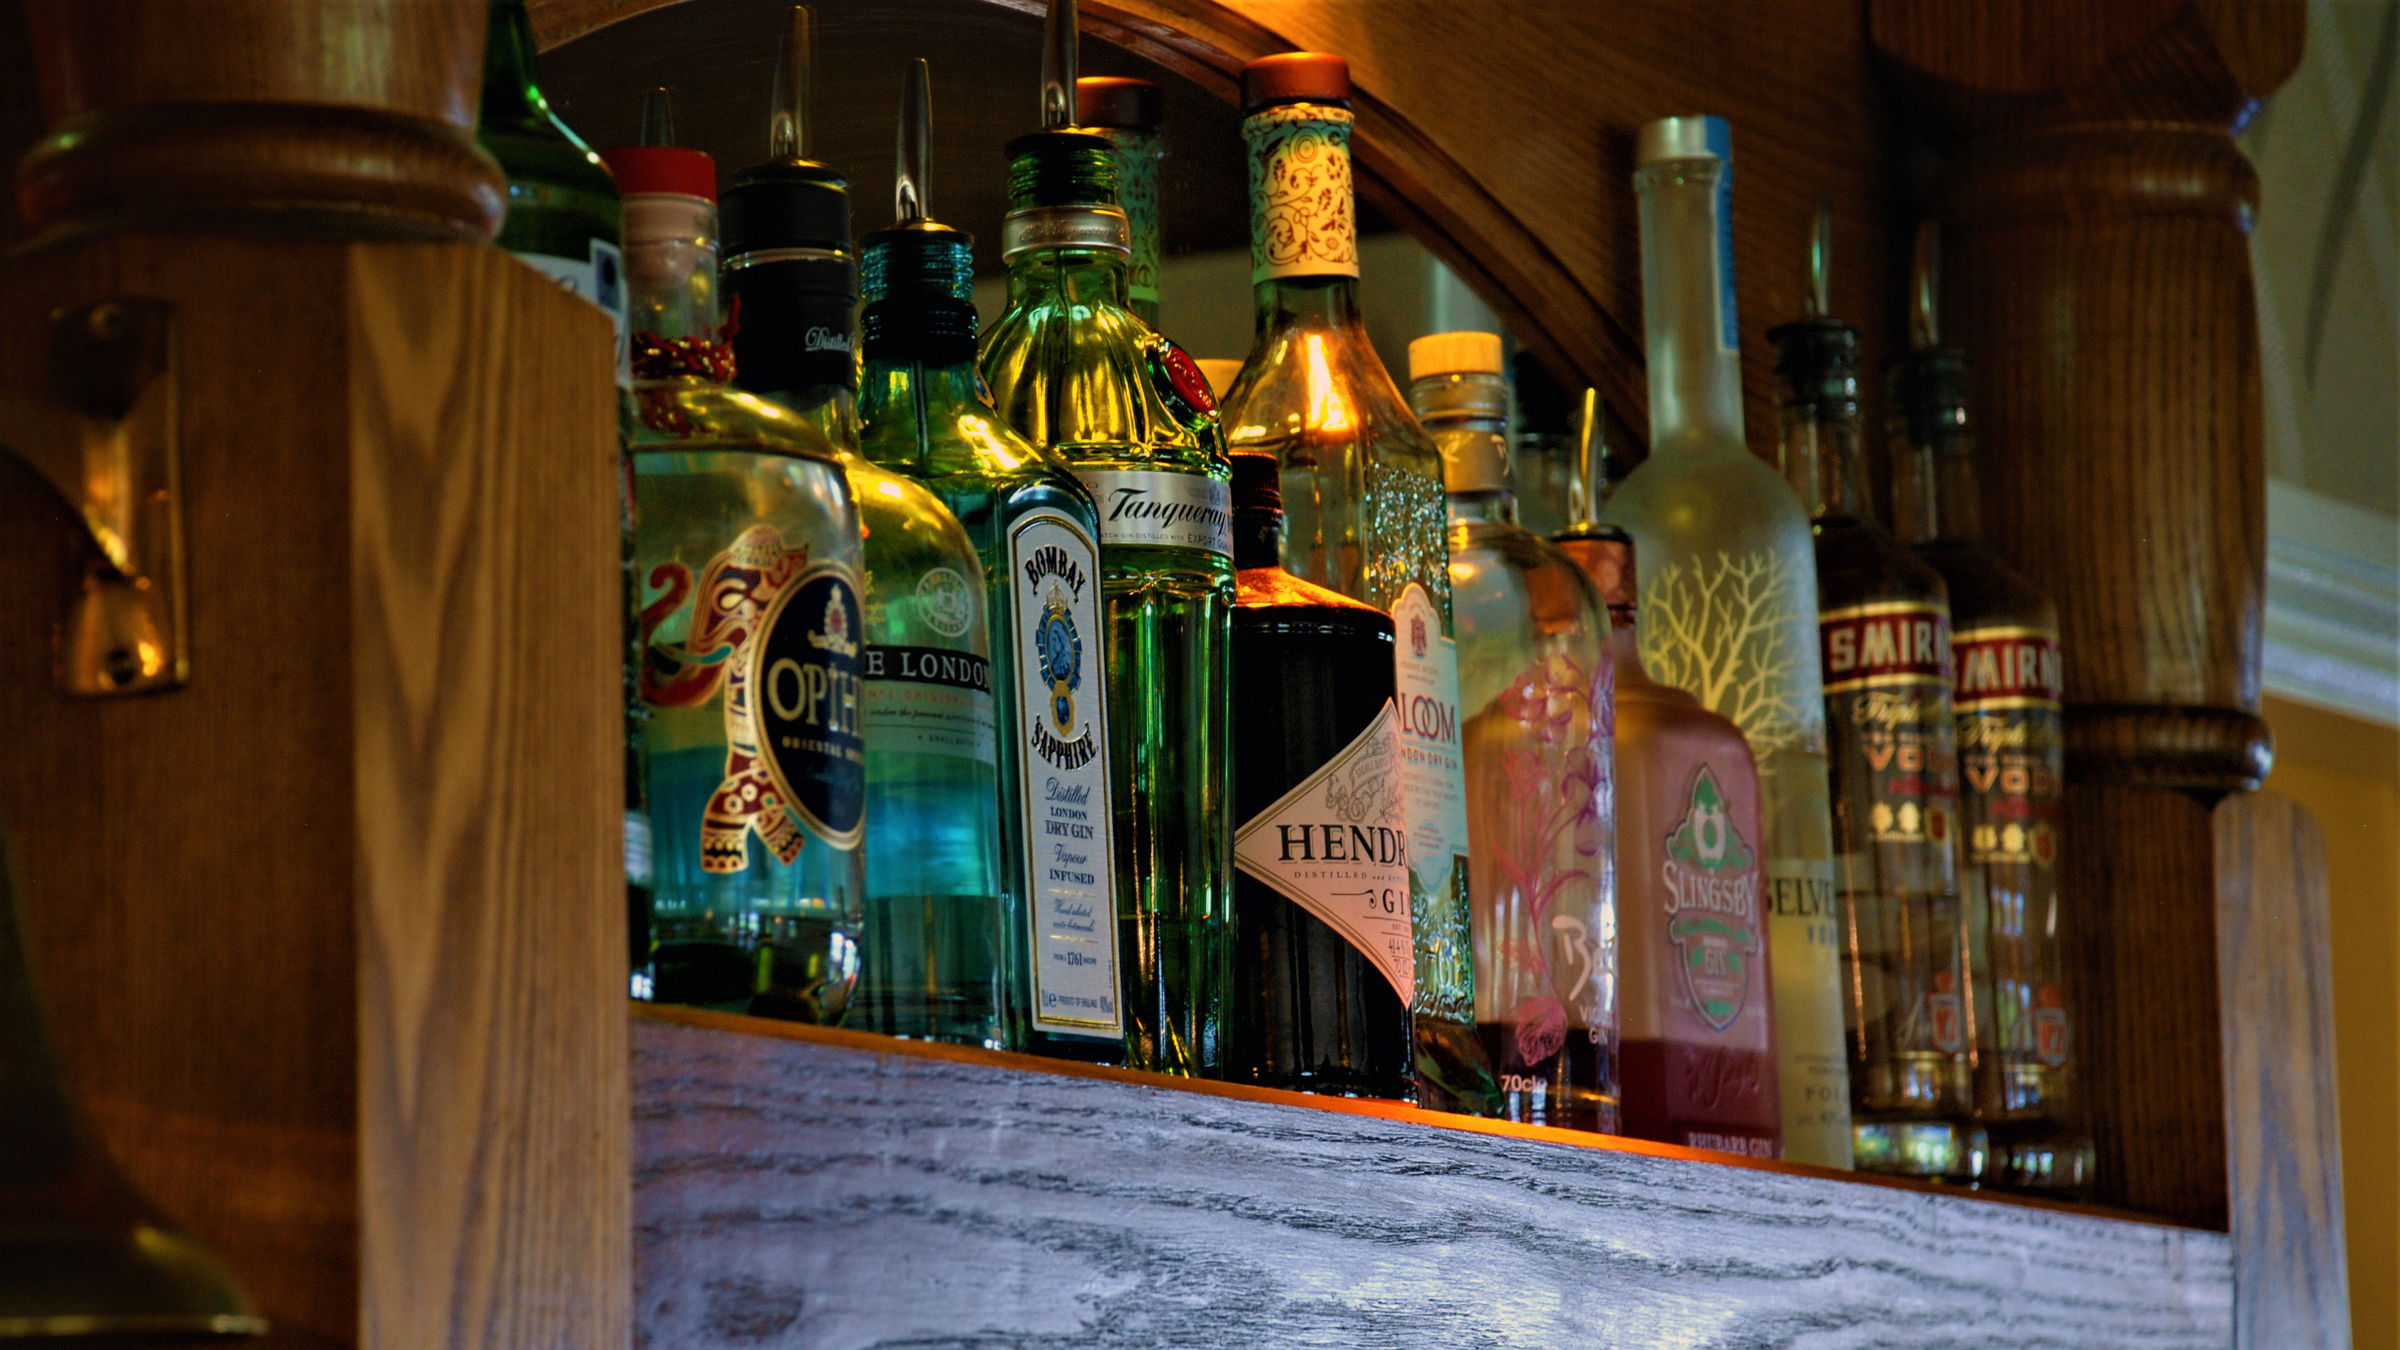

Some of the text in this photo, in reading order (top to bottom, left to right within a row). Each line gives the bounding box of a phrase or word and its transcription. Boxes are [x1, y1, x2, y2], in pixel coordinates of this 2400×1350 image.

[804, 326, 850, 352] Distilled
[1108, 487, 1227, 536] Tanqueray
[1188, 533, 1216, 547] EXPORT
[1025, 546, 1086, 604] BOMBAY
[1951, 644, 2063, 693] MIRN
[1400, 692, 1456, 744] LOOM
[1031, 714, 1096, 770] SAPPHIRE
[1045, 776, 1090, 806] Distilled
[1050, 806, 1088, 821] LONDON
[1045, 820, 1094, 840] DRY GIN
[1054, 843, 1087, 868] Vapour
[1049, 868, 1095, 886] INFUSED
[1294, 871, 1367, 879] DISTILLED
[1382, 888, 1411, 916] GI
[1662, 859, 1760, 926] SLINGSBY
[1067, 952, 1083, 967] 1761
[1688, 1132, 1773, 1158] RHUBARB GIN
